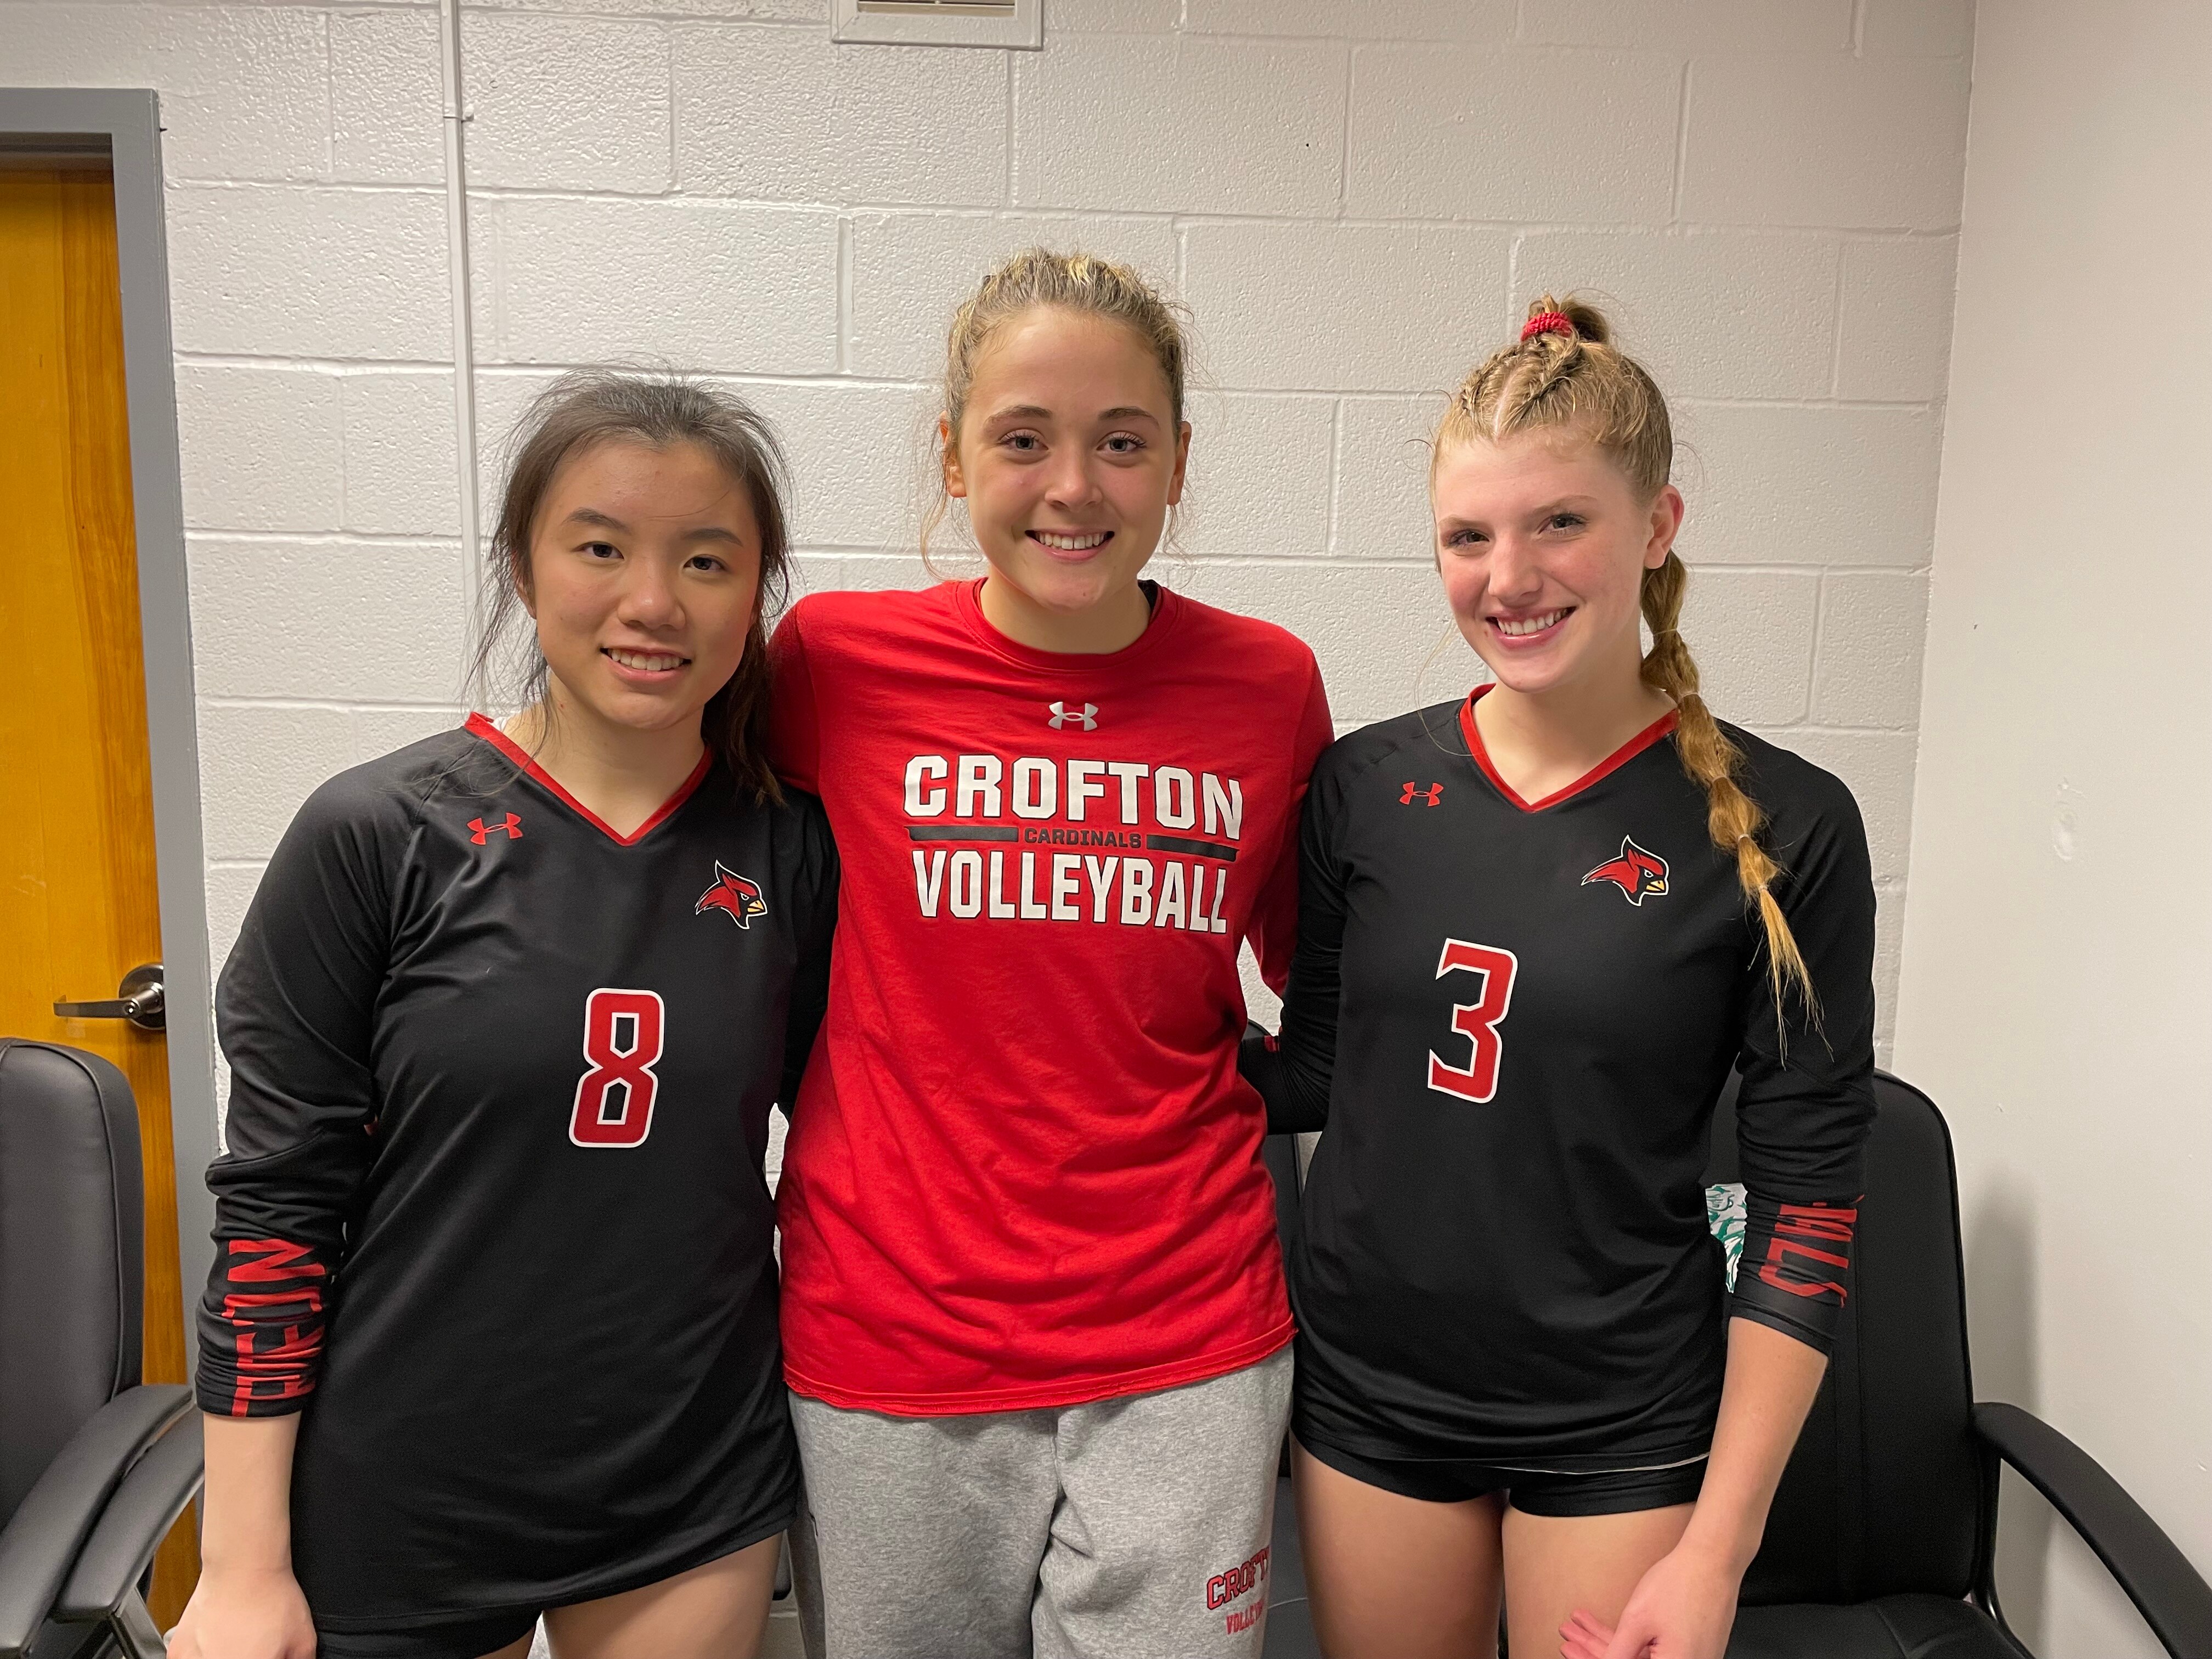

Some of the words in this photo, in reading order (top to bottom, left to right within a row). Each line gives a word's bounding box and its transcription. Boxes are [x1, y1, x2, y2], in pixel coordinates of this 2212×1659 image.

[903, 754, 1244, 840] CROFTON
[1024, 827, 1142, 849] CARDINALS
[911, 850, 1227, 934] VOLLEYBALL
[1427, 938, 1518, 1103] 3
[569, 988, 665, 1148] 8
[1207, 1544, 1271, 1610] CROFT
